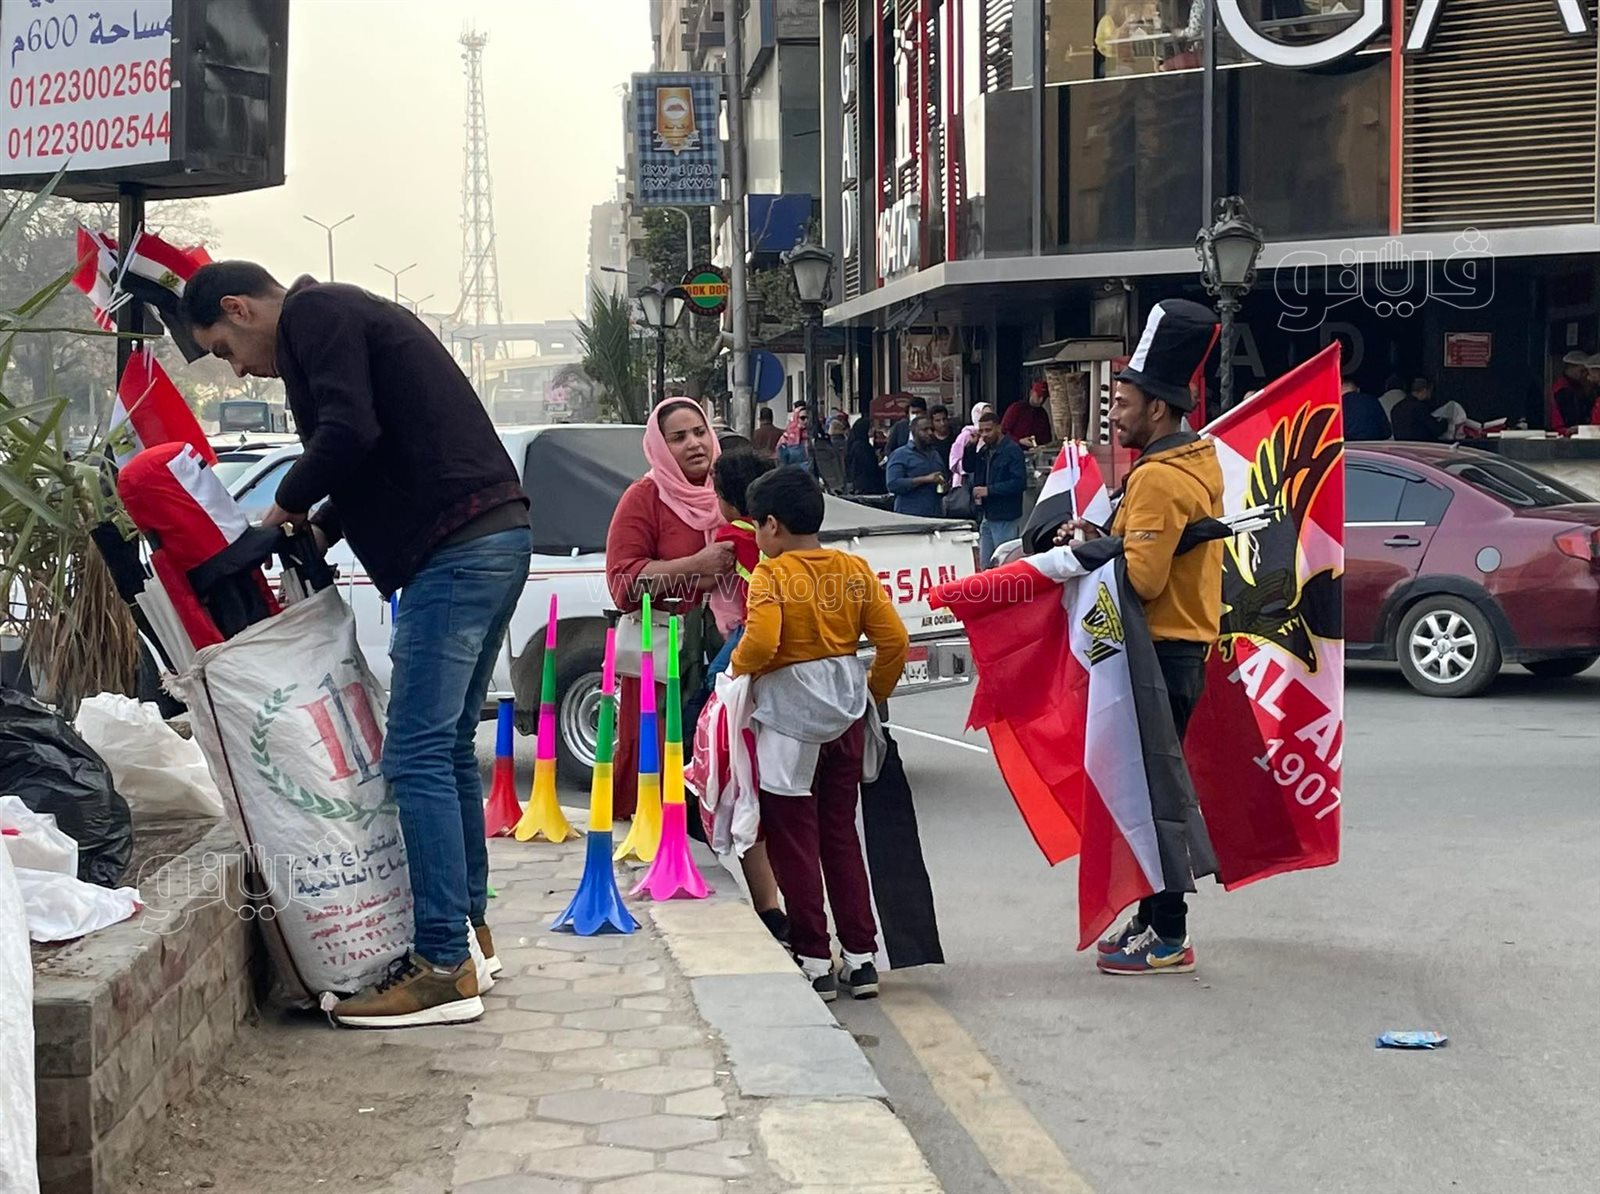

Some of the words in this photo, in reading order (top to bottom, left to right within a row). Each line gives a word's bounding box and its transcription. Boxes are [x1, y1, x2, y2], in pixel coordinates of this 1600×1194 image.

[88, 9, 172, 45] مساحة
[9, 57, 172, 109] 01223002566
[8, 111, 170, 159] 01223002544
[1227, 645, 1290, 722] AL
[1253, 738, 1341, 820] 1907
